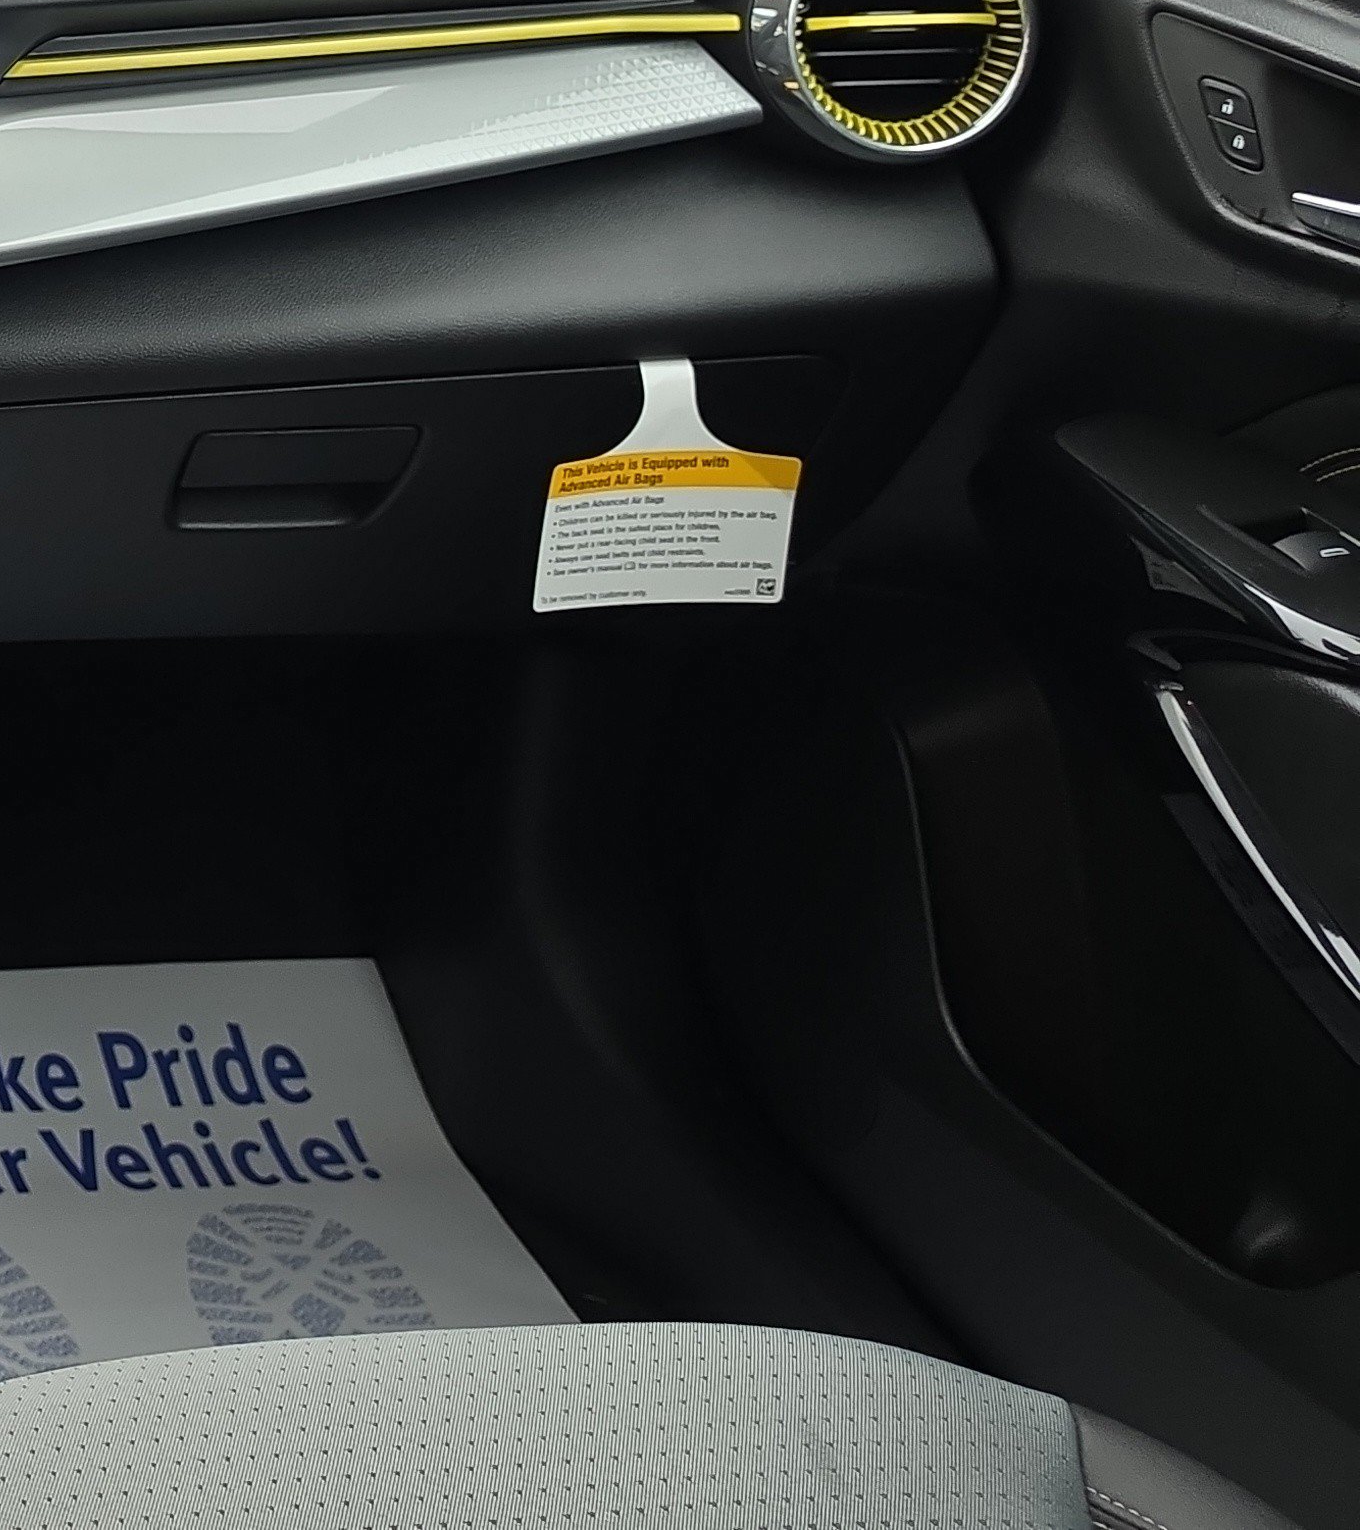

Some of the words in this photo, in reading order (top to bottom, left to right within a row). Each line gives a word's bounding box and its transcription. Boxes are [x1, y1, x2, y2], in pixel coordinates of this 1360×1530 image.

[562, 466, 583, 479] This
[587, 461, 626, 476] Vehicle
[628, 460, 638, 470] is
[641, 457, 698, 471] Equipped
[701, 456, 730, 468] with
[559, 475, 611, 492] Advanced
[614, 474, 632, 485] Air
[634, 473, 663, 486] Bags
[592, 497, 630, 507] Advanced
[96, 1021, 313, 1111] Pride
[39, 1118, 385, 1193] Vehicle!
